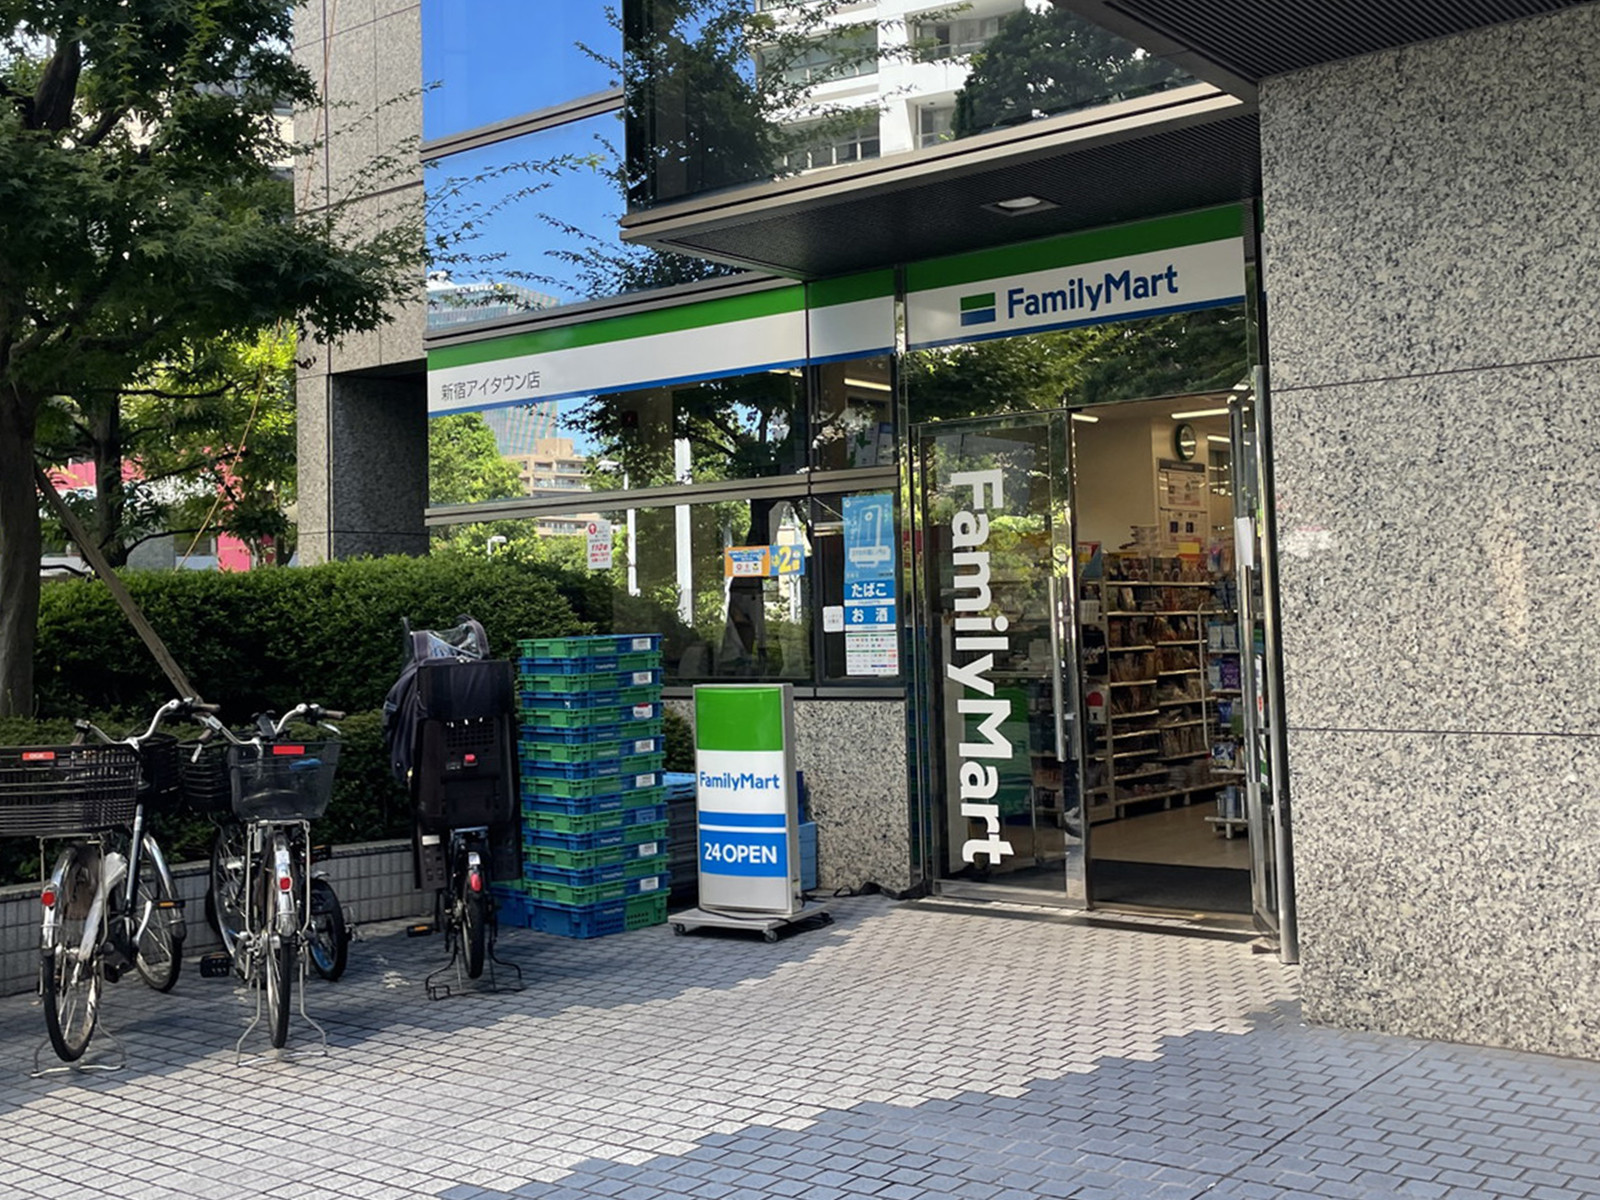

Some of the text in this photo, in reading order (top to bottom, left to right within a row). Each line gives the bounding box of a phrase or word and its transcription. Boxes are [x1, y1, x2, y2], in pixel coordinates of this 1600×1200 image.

[1007, 264, 1179, 319] FamilyMart
[441, 371, 541, 401] 新宿アイタウン店
[851, 583, 887, 598] たばこ
[947, 469, 1015, 865] FamilyMart
[700, 771, 780, 791] FamilyMart
